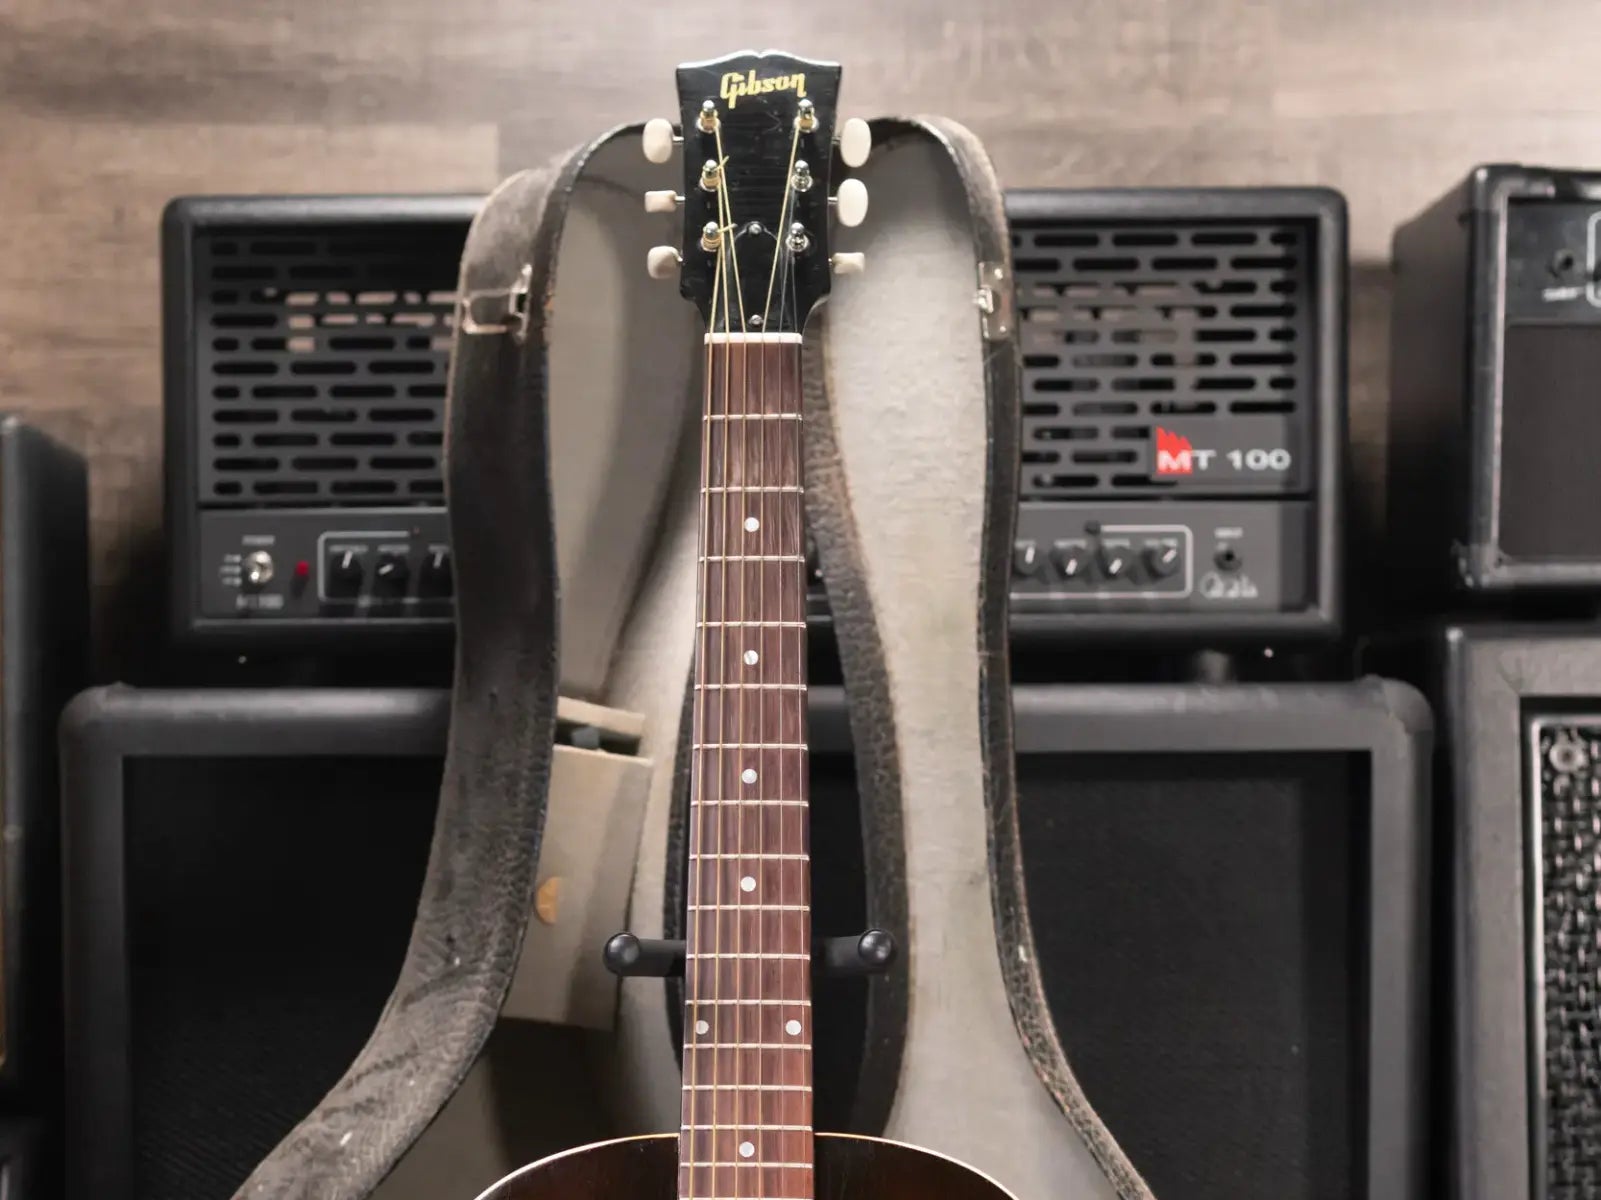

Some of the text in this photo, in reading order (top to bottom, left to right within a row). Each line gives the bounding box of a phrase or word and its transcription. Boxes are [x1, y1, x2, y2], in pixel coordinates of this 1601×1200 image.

[720, 69, 807, 109] Gibson
[1157, 448, 1292, 471] MT 100
